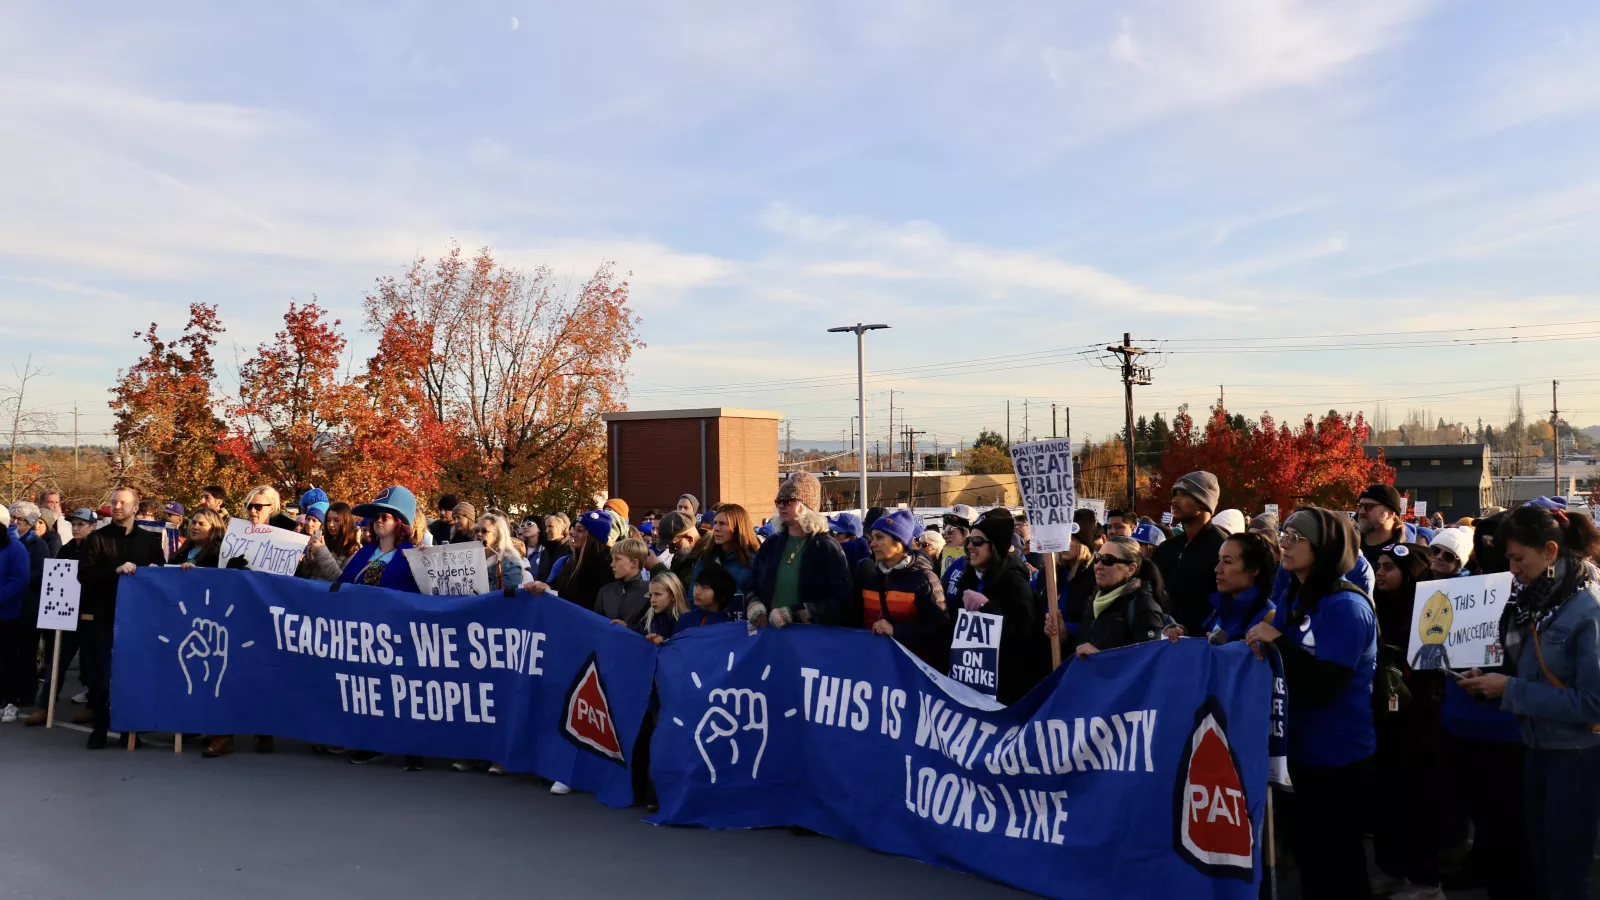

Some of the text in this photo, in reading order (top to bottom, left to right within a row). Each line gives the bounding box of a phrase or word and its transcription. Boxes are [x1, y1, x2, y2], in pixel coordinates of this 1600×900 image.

[1020, 473, 1073, 495] PBLIC
[1048, 507, 1072, 525] ALL
[252, 540, 301, 575] MATTERS
[1454, 589, 1497, 611] THIS IS
[269, 605, 546, 677] TEACHERS: WE SERVE
[955, 613, 995, 646] PAT
[952, 664, 995, 688] STRIKE
[962, 650, 983, 668] ON
[335, 672, 496, 724] THE PEOPLE
[577, 698, 607, 734] PAT
[800, 667, 1158, 776] THIS IS WHAT SOLIDARITY
[905, 754, 1069, 846] LOOKS LIKE
[1189, 784, 1242, 827] PAT
